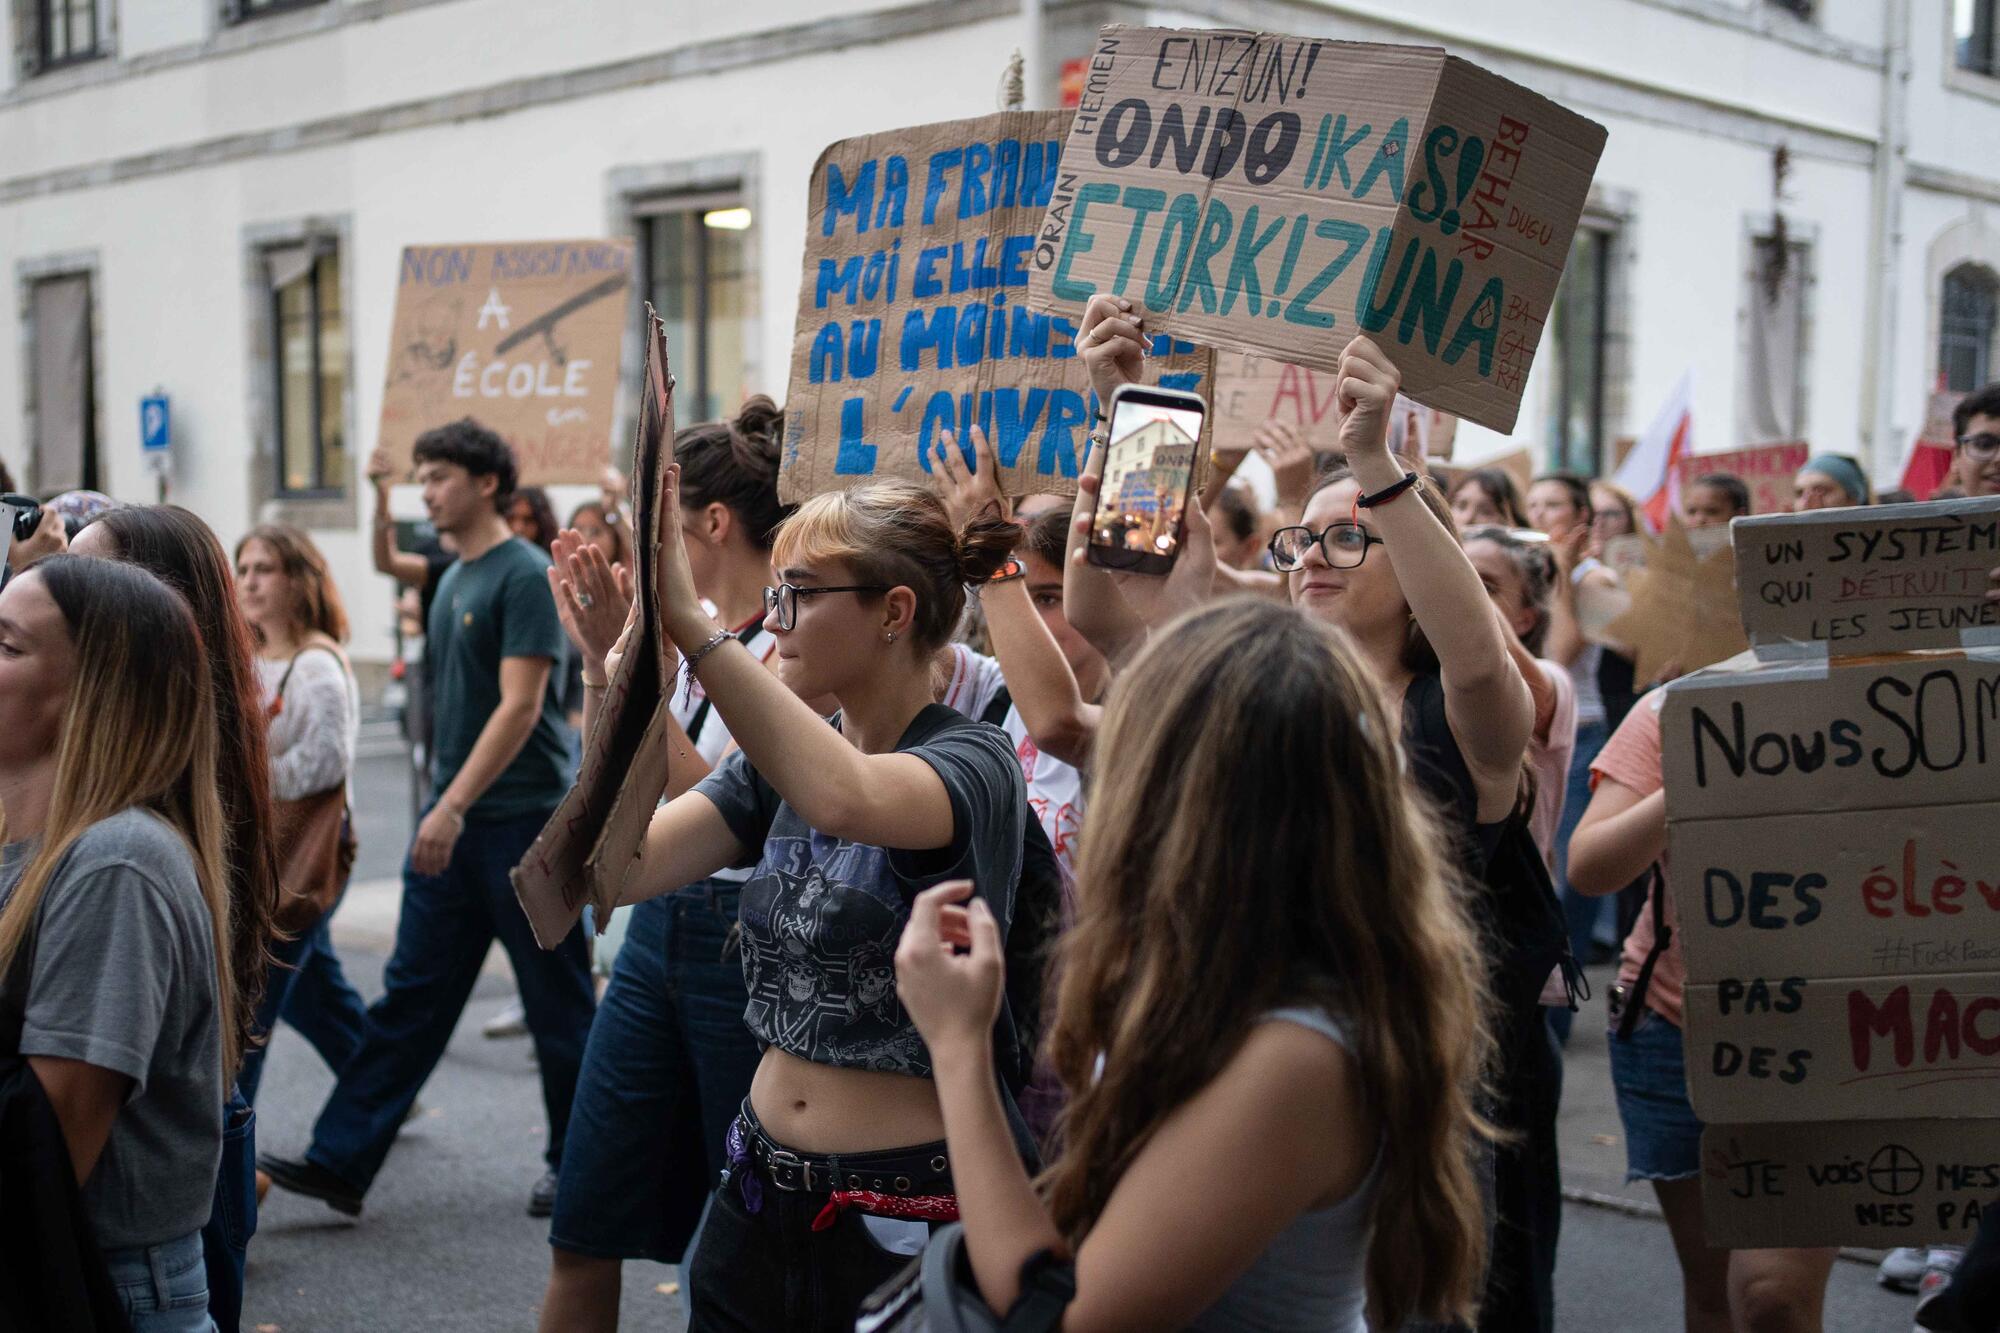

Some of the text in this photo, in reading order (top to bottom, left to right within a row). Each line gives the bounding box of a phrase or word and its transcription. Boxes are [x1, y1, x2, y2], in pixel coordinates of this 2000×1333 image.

[1074, 38, 1121, 135] HEMEN
[1151, 36, 1322, 105] ENTZUN!
[821, 138, 1060, 237] MA FRAN
[1095, 98, 1485, 236] ONDO IKAS!
[1457, 113, 1530, 261] BEHAR
[1506, 205, 1553, 247] DUGU
[401, 248, 476, 288] NON
[912, 234, 1036, 299] ELLE
[476, 287, 512, 330] A
[452, 351, 594, 399] ÉCOLE
[808, 319, 882, 385] AU
[1268, 362, 1339, 425] AV
[834, 384, 1105, 479] L'OUVR
[1765, 514, 2000, 565] UN SYSTÈM
[1811, 601, 2000, 641] LES JEUNE
[1703, 867, 1828, 930] DES
[1717, 976, 1808, 1015] PAS
[1712, 1041, 1813, 1085] DES
[1727, 1159, 1788, 1199] JE
[1936, 1163, 2000, 1191] MES
[1936, 1199, 1983, 1231] PA
